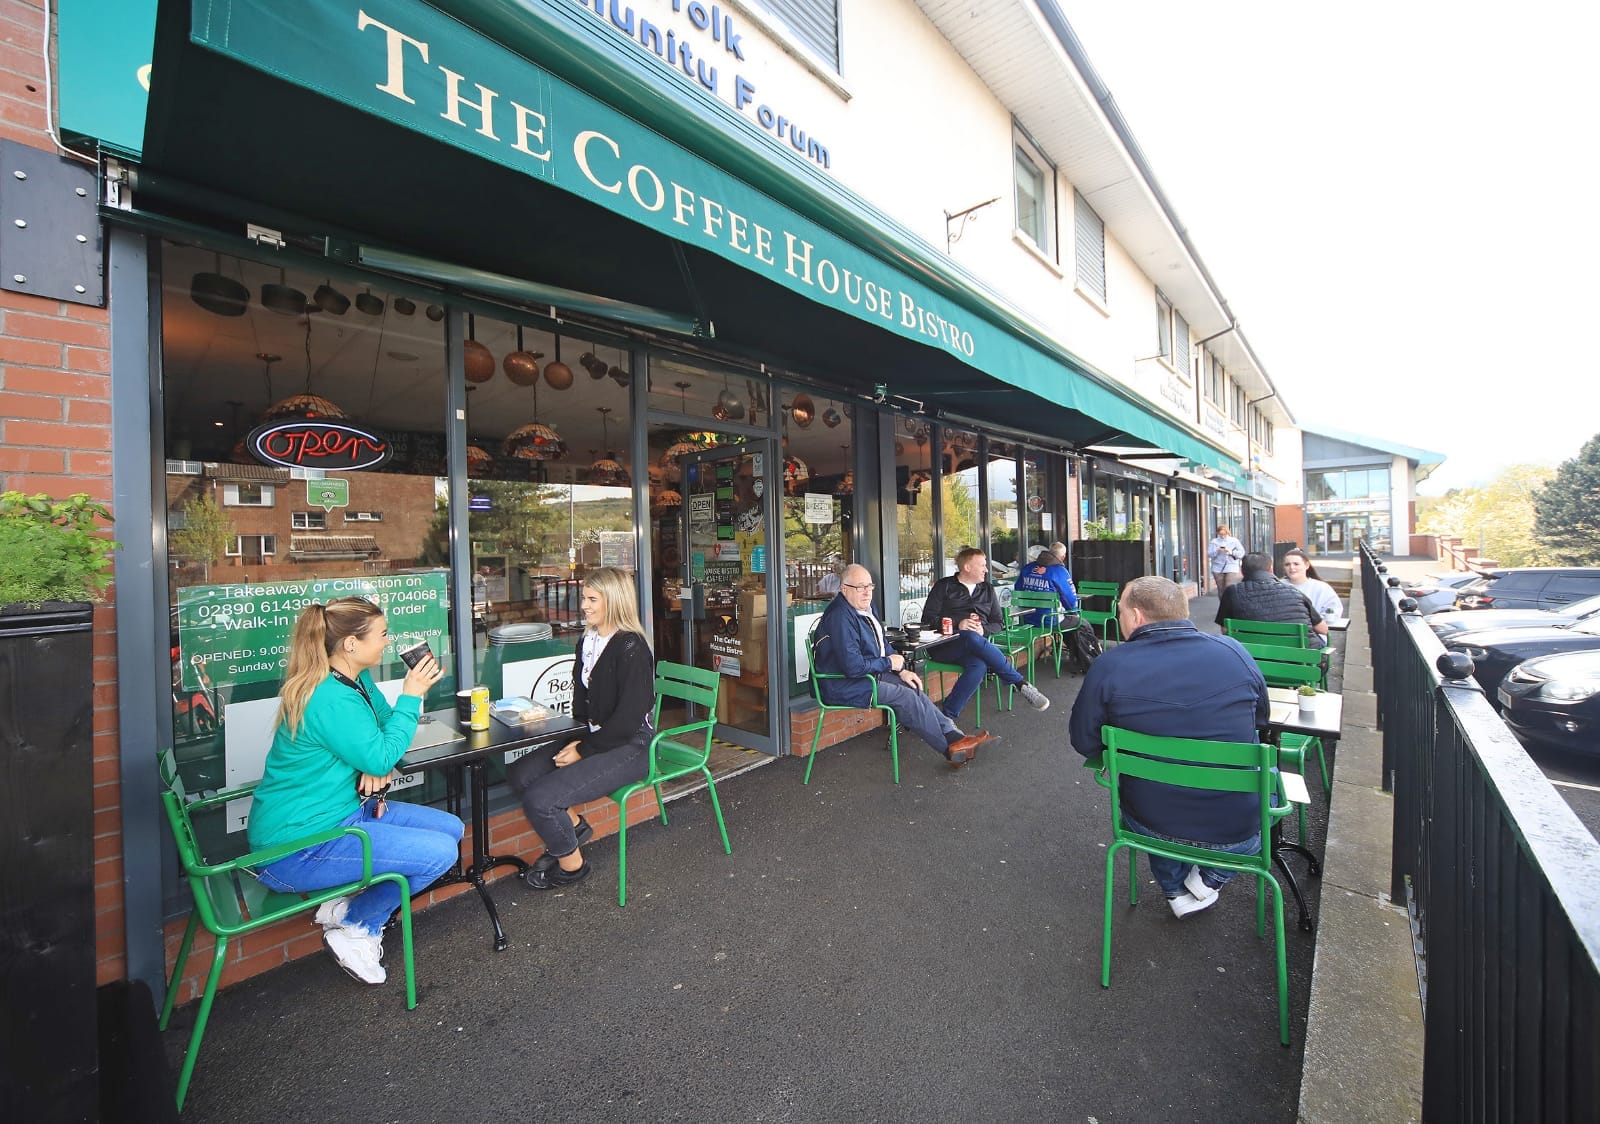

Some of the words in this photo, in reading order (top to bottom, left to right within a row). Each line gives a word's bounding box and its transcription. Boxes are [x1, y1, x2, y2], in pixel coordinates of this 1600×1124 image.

[735, 74, 832, 169] Forum
[357, 9, 552, 162] THE
[573, 130, 775, 267] COFFEE
[783, 230, 894, 321] HOUSE
[900, 290, 976, 358] BISTRO
[221, 583, 308, 598] Takeaway
[313, 582, 329, 592] or
[333, 578, 402, 591] Collection
[406, 577, 422, 587] on
[1023, 576, 1050, 589] YAMAHA
[198, 602, 255, 618] 02890
[392, 604, 427, 615] order
[223, 614, 289, 631] Walk-In
[191, 649, 256, 664] OPENED:
[228, 661, 275, 674] Sunday
